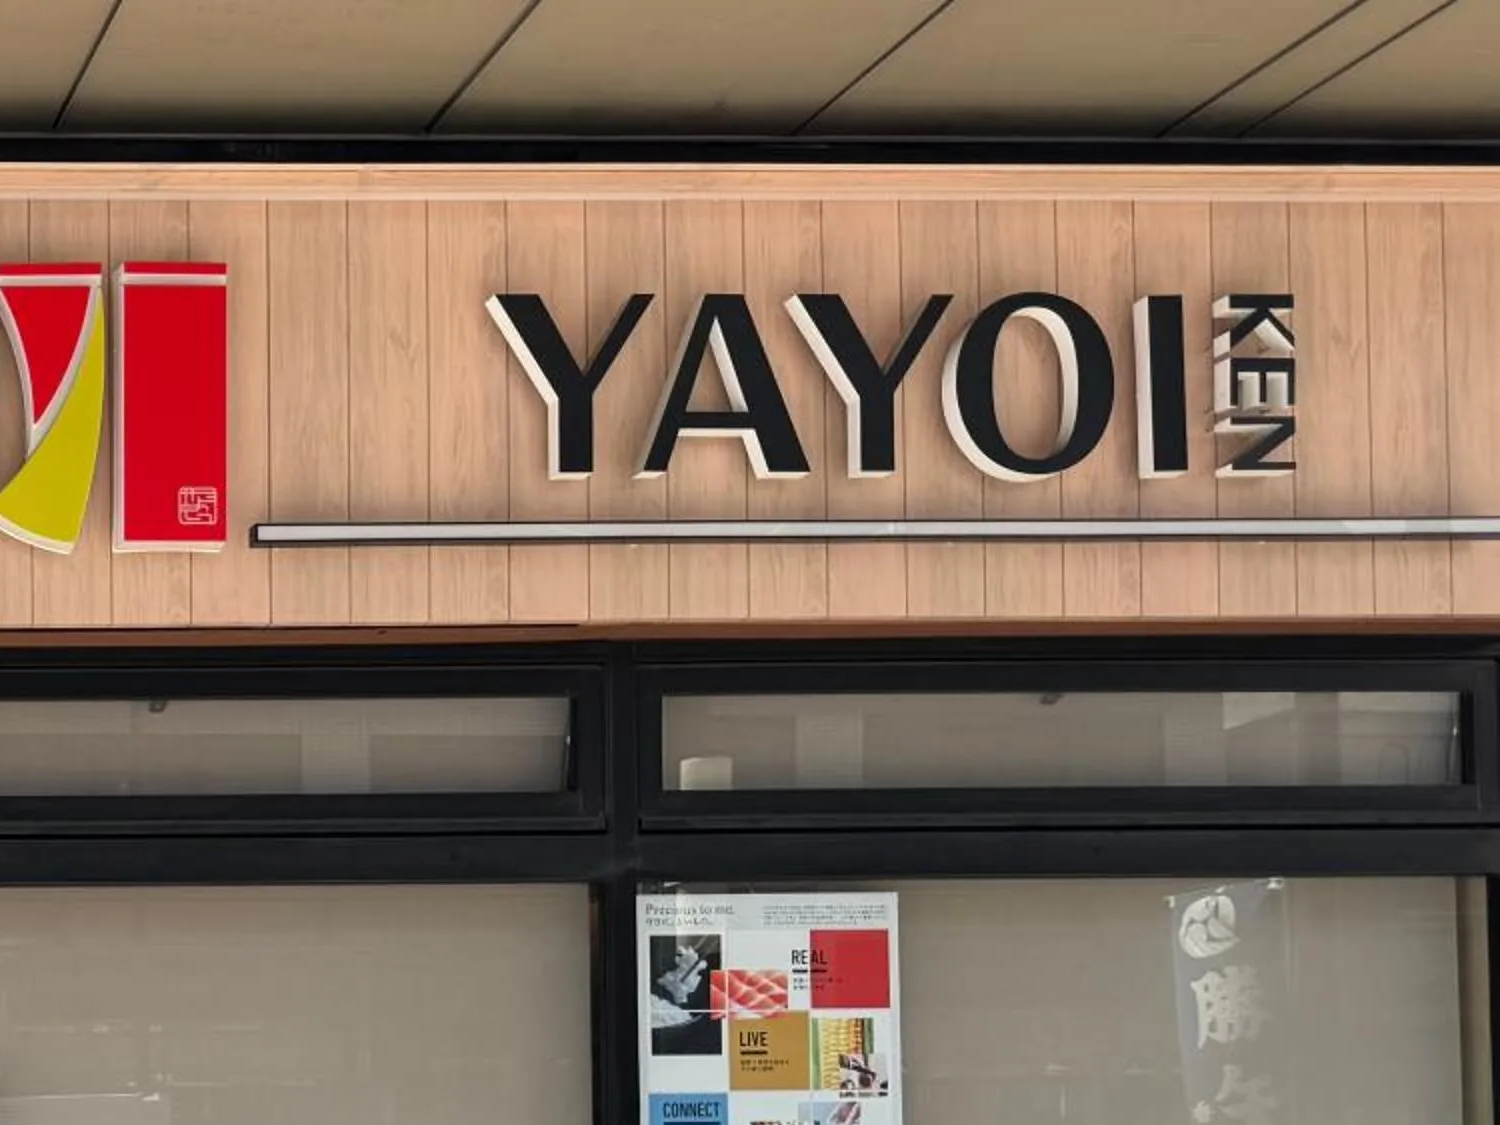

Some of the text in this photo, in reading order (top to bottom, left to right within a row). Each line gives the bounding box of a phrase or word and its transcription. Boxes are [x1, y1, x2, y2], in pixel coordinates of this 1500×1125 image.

[487, 291, 1190, 481] YAYOI
[1213, 293, 1297, 477] KEN
[791, 950, 828, 965] REAL
[739, 1032, 768, 1047] LIVE
[662, 1102, 720, 1118] CONNECT
